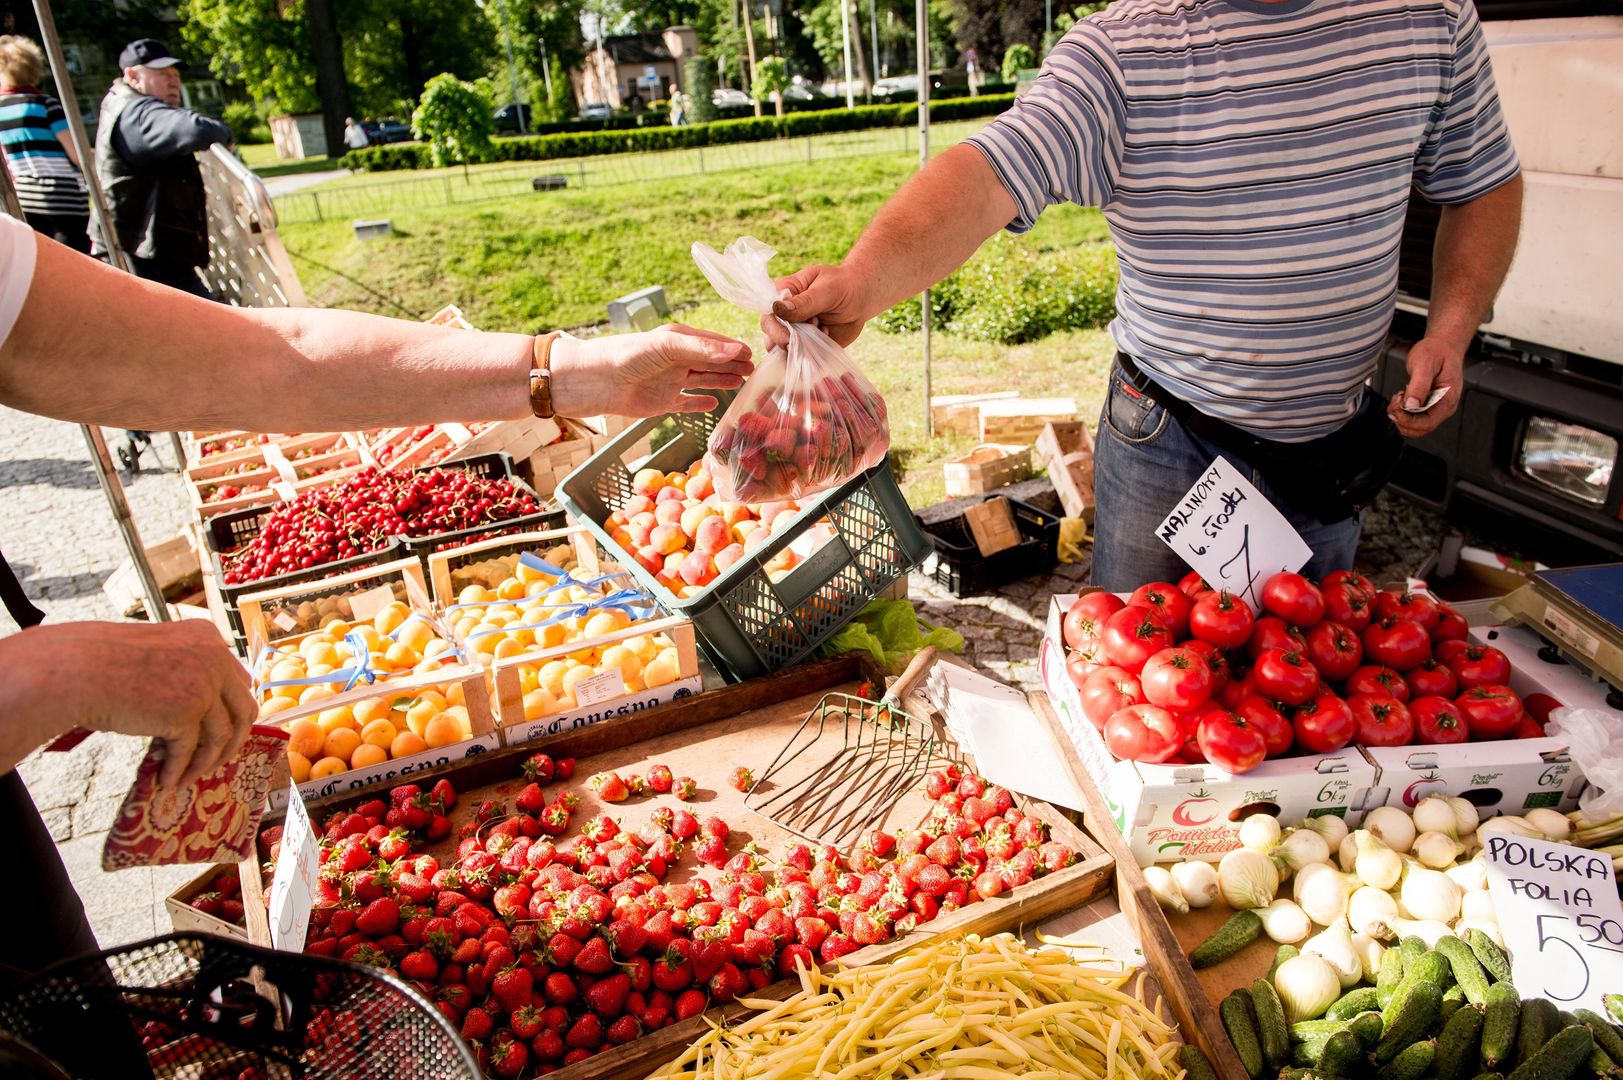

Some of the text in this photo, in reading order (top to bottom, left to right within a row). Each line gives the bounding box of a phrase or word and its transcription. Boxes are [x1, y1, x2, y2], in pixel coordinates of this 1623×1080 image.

[1219, 524, 1261, 609] 7
[1538, 765, 1564, 789] 6kg
[1316, 780, 1346, 805] 6kg
[1488, 837, 1608, 881] POLSKA
[1507, 878, 1593, 908] FOLIA
